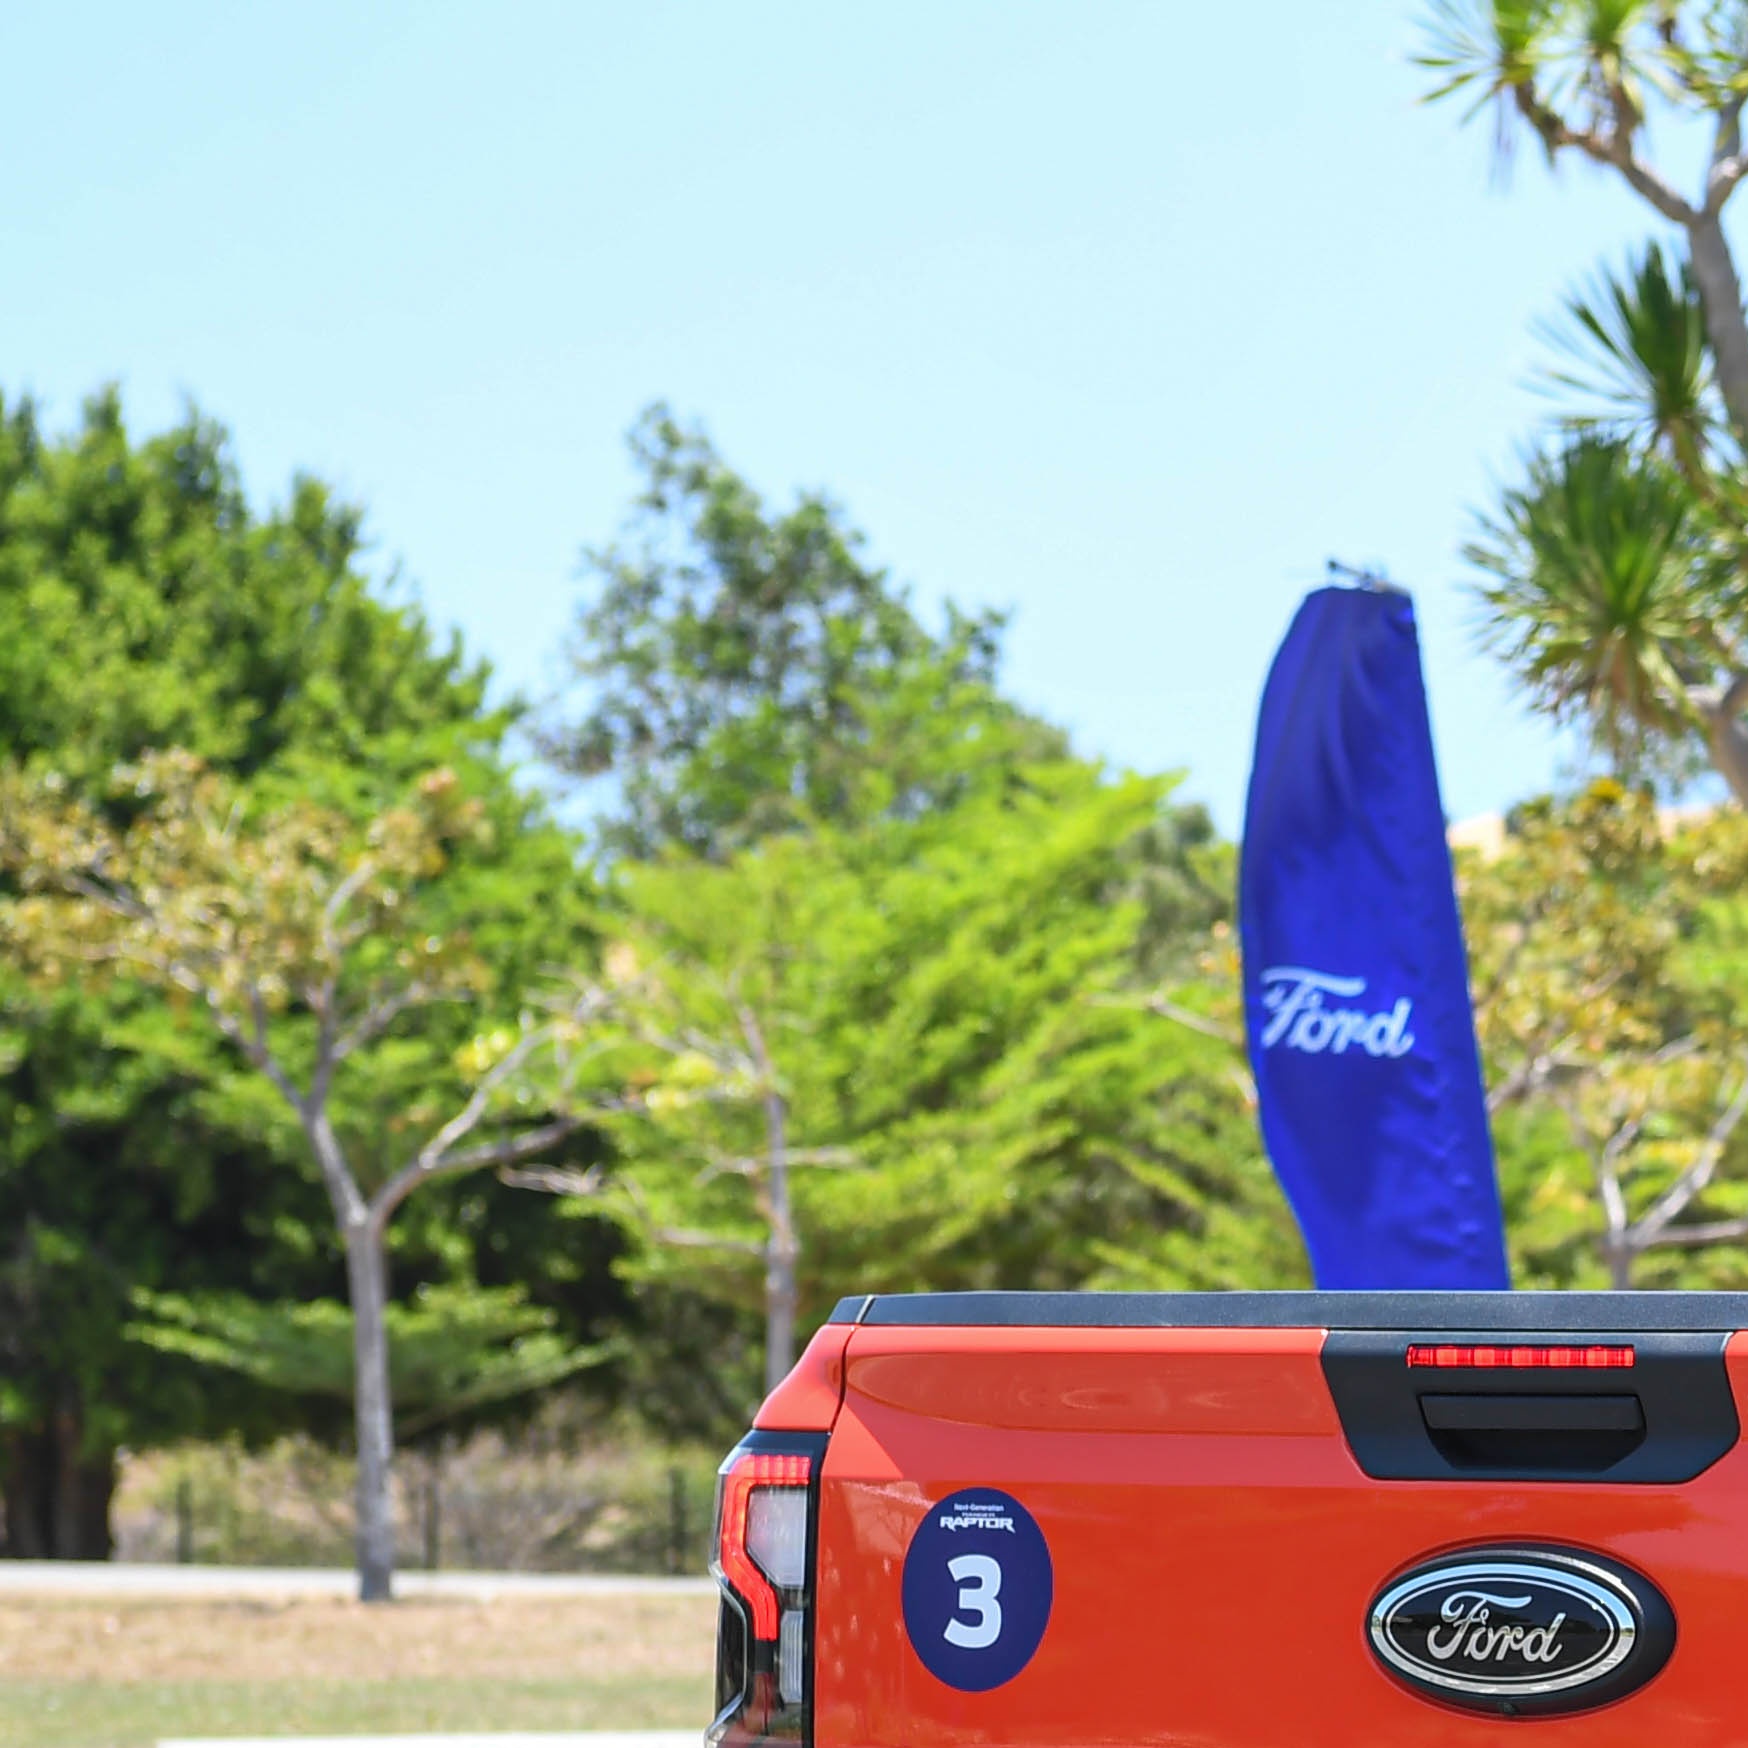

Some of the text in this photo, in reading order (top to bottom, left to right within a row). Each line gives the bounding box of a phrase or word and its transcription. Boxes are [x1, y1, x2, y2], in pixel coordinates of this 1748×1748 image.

[1260, 965, 1415, 1058] Ford
[940, 1516, 1016, 1533] RAPTOR
[943, 1553, 1003, 1650] 3
[1427, 1591, 1567, 1665] Ford
